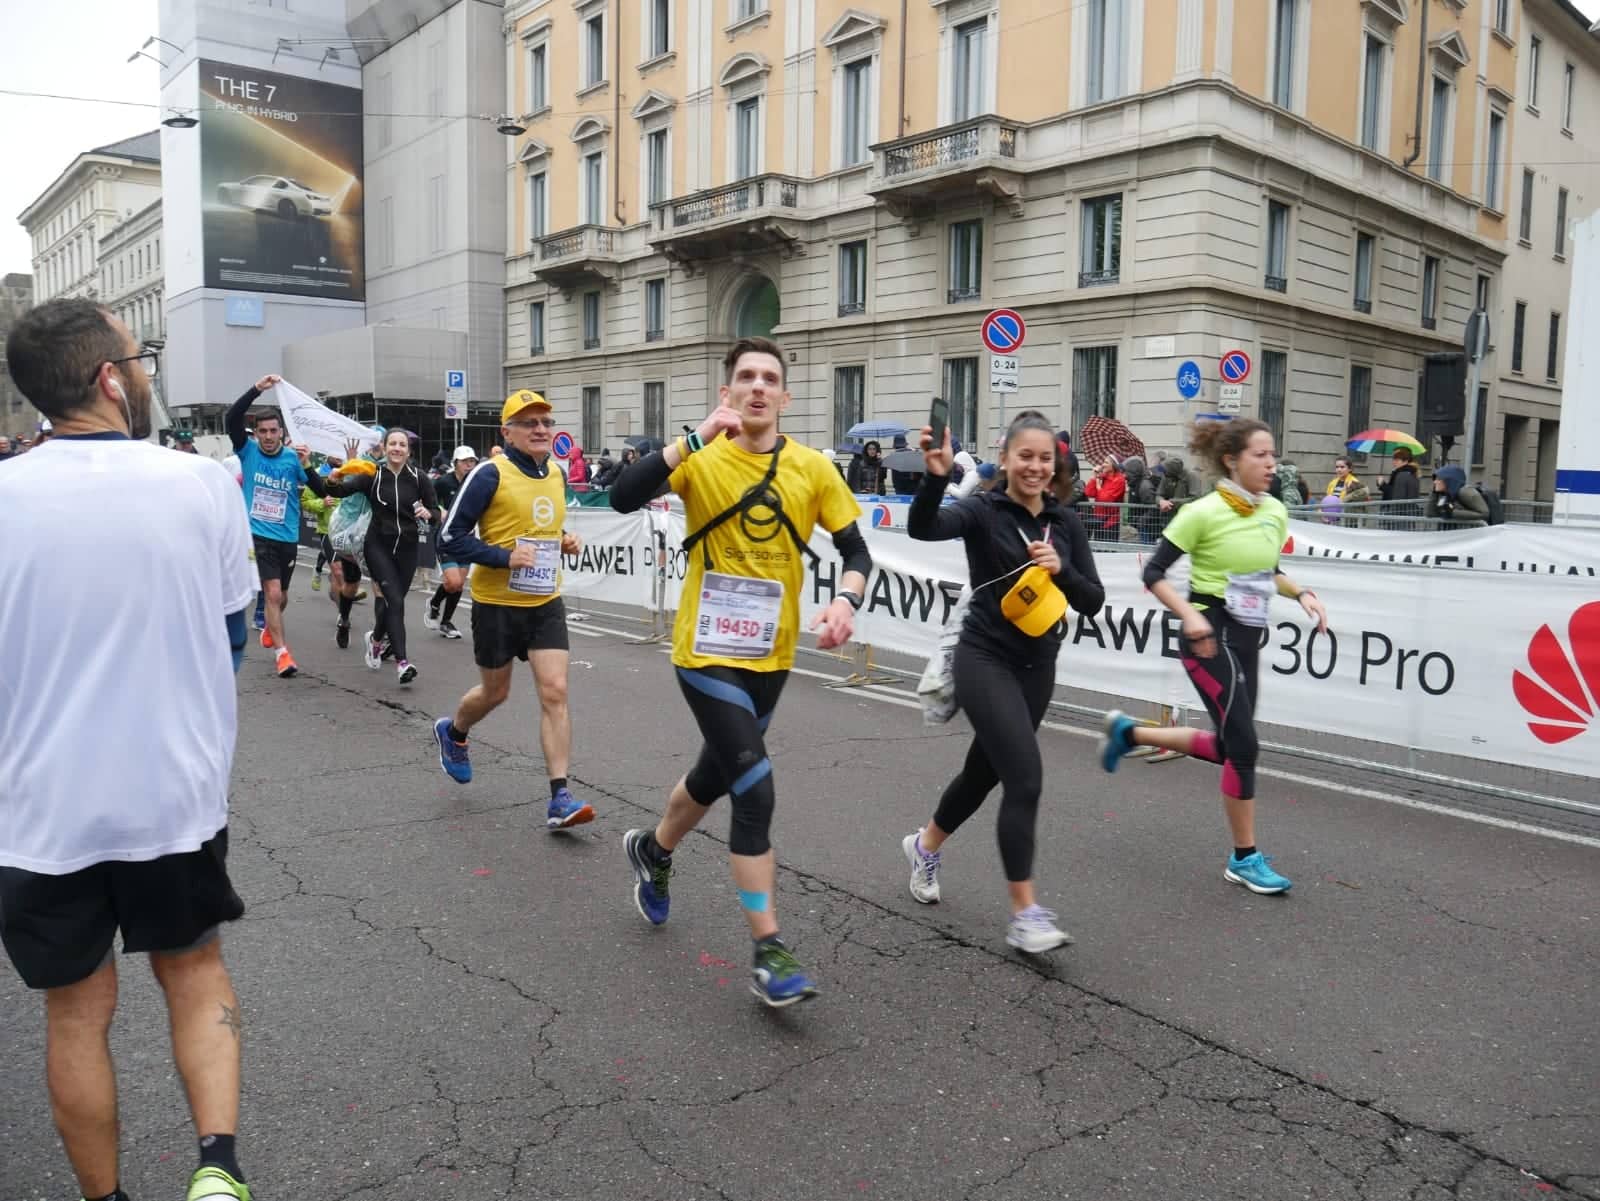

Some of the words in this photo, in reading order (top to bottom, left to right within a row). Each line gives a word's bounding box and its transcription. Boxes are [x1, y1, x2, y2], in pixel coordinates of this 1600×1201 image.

[214, 75, 260, 101] THE
[264, 84, 277, 103] 7
[259, 107, 298, 122] HYBRID
[451, 373, 461, 387] P
[253, 472, 292, 491] meals
[560, 544, 634, 576] UAWEI
[813, 561, 965, 626] HAWE
[716, 616, 761, 638] 1943D
[1258, 621, 1338, 680] 30
[1359, 630, 1455, 696] Pro
